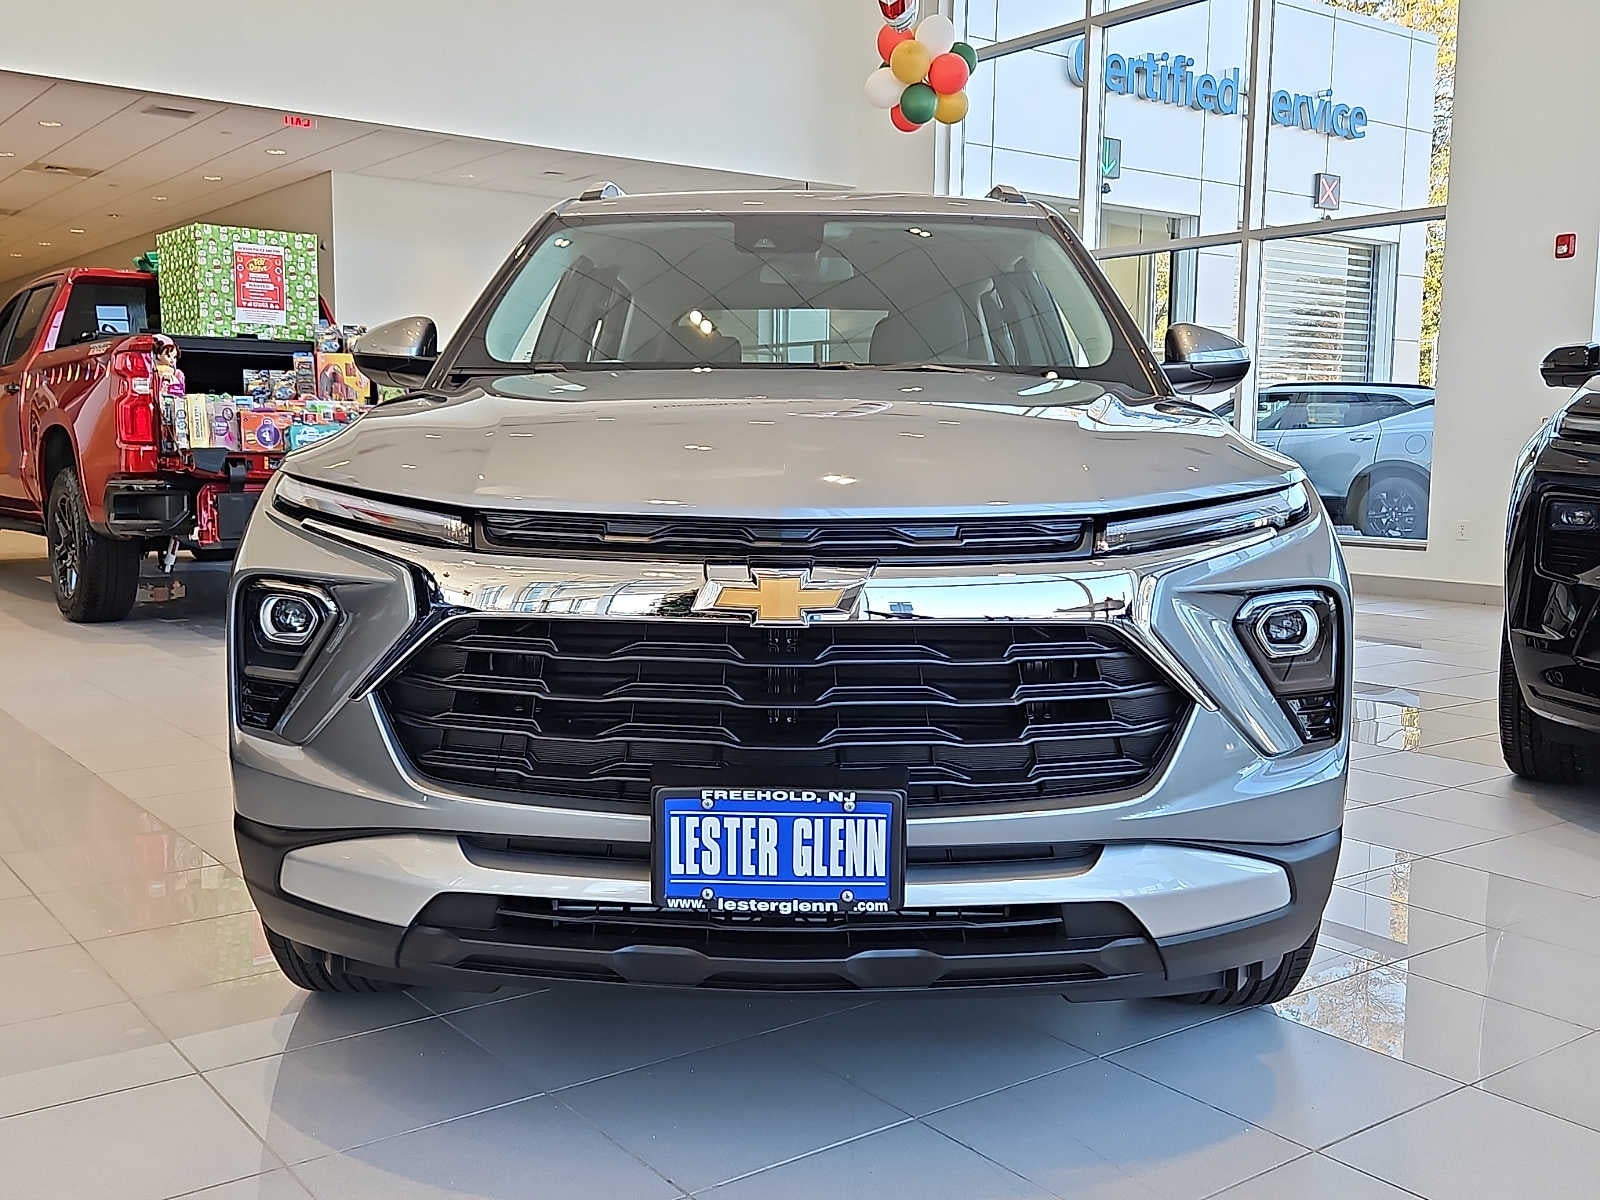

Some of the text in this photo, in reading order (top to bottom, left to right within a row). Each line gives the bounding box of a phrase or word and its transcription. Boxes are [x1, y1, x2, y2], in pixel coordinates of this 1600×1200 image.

[1271, 88, 1368, 139] ervice
[701, 790, 856, 803] FREEHOLD, NJ
[670, 816, 887, 877] LESTER GLENN
[667, 898, 888, 915] www. lesterglenn .com
